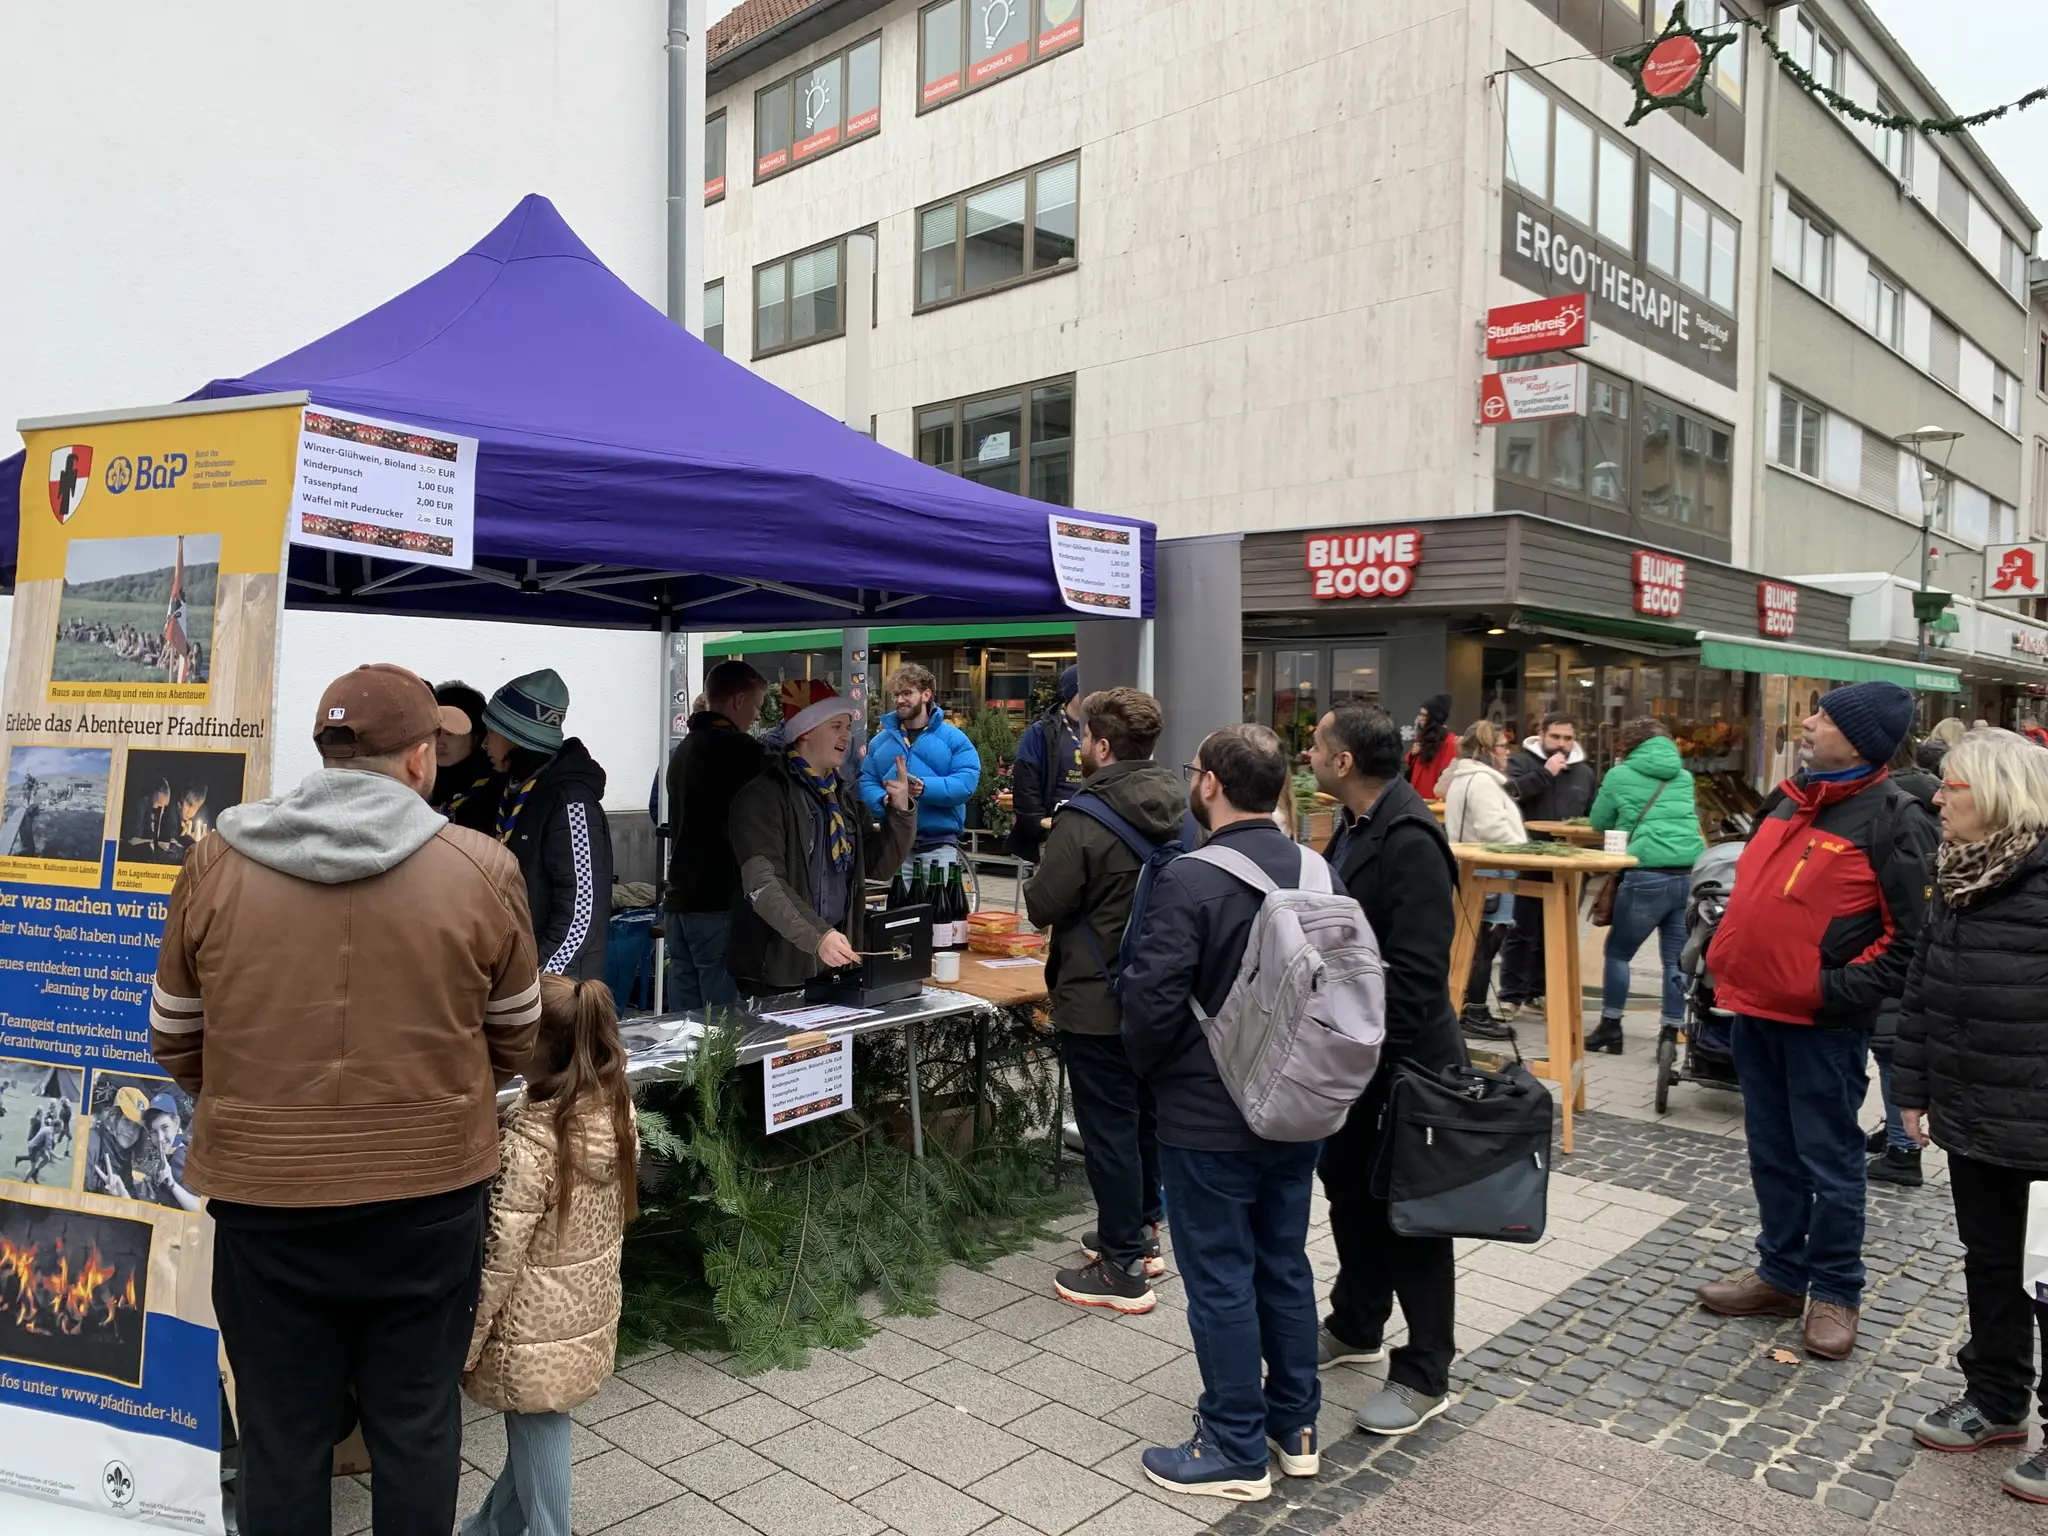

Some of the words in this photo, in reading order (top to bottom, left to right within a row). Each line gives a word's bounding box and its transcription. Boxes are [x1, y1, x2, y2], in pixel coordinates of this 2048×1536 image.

[1039, 25, 1080, 49] Studienkreis
[976, 54, 1014, 76] NACHHILFE
[848, 112, 878, 132] NACHHILFE
[760, 153, 787, 170] NACHHILFE
[1516, 211, 1690, 340] ERGOTHERAPIE
[1488, 316, 1566, 339] Studienkreis
[1506, 374, 1538, 385] Regina
[1526, 381, 1548, 390] Kopf
[1514, 394, 1562, 406] Ergotherapie
[1517, 404, 1569, 414] Rehabilitation
[303, 458, 363, 478] Kinderpunsch
[304, 440, 382, 466] Winzer-Glühwein,
[384, 457, 416, 471] Bioland
[438, 468, 456, 478] EUR
[134, 452, 188, 492] BdP
[303, 476, 358, 494] Tassenpfand
[418, 481, 435, 492] 1,00
[437, 484, 454, 495] EUR
[302, 493, 332, 506] Waffel
[334, 500, 348, 509] mit
[351, 502, 403, 519] Puderzucker
[436, 517, 453, 527] EUR
[416, 497, 434, 508] 2,00
[436, 500, 453, 511] EUR
[1308, 533, 1416, 568] BLUME
[1315, 566, 1406, 595] 2000
[1640, 555, 1685, 589] BLUME
[1642, 585, 1680, 614] 2000
[1764, 585, 1798, 613] BLUME
[1766, 611, 1794, 633] 2000
[52, 688, 70, 697] Raus
[71, 690, 85, 698] aus
[86, 689, 101, 698] dem
[103, 688, 121, 700] Alltag
[122, 689, 137, 698] und
[139, 689, 154, 699] rein
[156, 690, 167, 699] ins
[168, 690, 206, 700] Abenteuer
[536, 704, 564, 725] VA
[5, 714, 41, 732] Erlebe
[44, 714, 72, 732] das
[76, 714, 163, 735] Abenteuer
[166, 717, 264, 738] Pfadfinden!
[43, 863, 67, 872] Kulturen
[129, 869, 160, 879] Lagerfeuer
[161, 873, 178, 881] singe
[116, 880, 142, 888] erzählen
[0, 889, 18, 907] ber
[22, 895, 51, 910] was
[54, 896, 112, 916] machen
[116, 900, 144, 919] wir
[147, 902, 168, 920] üb
[17, 922, 52, 938] Natur
[54, 925, 77, 941] Spaß
[79, 927, 116, 944] haben
[119, 932, 141, 947] und
[0, 959, 24, 970] eues
[26, 960, 81, 977] entdecken
[84, 966, 108, 980] und
[110, 967, 133, 982] sich
[135, 973, 155, 984] aus
[92, 984, 108, 1001] by
[0, 1012, 55, 1032] Teamgeist
[56, 1022, 122, 1040] entwickeln
[125, 1029, 148, 1043] und
[84, 1045, 99, 1057] zu
[102, 1045, 158, 1064] überneh
[0, 1374, 20, 1389] fos
[22, 1380, 58, 1397] unter
[61, 1387, 198, 1429] www.pfadfinder-kl.de
